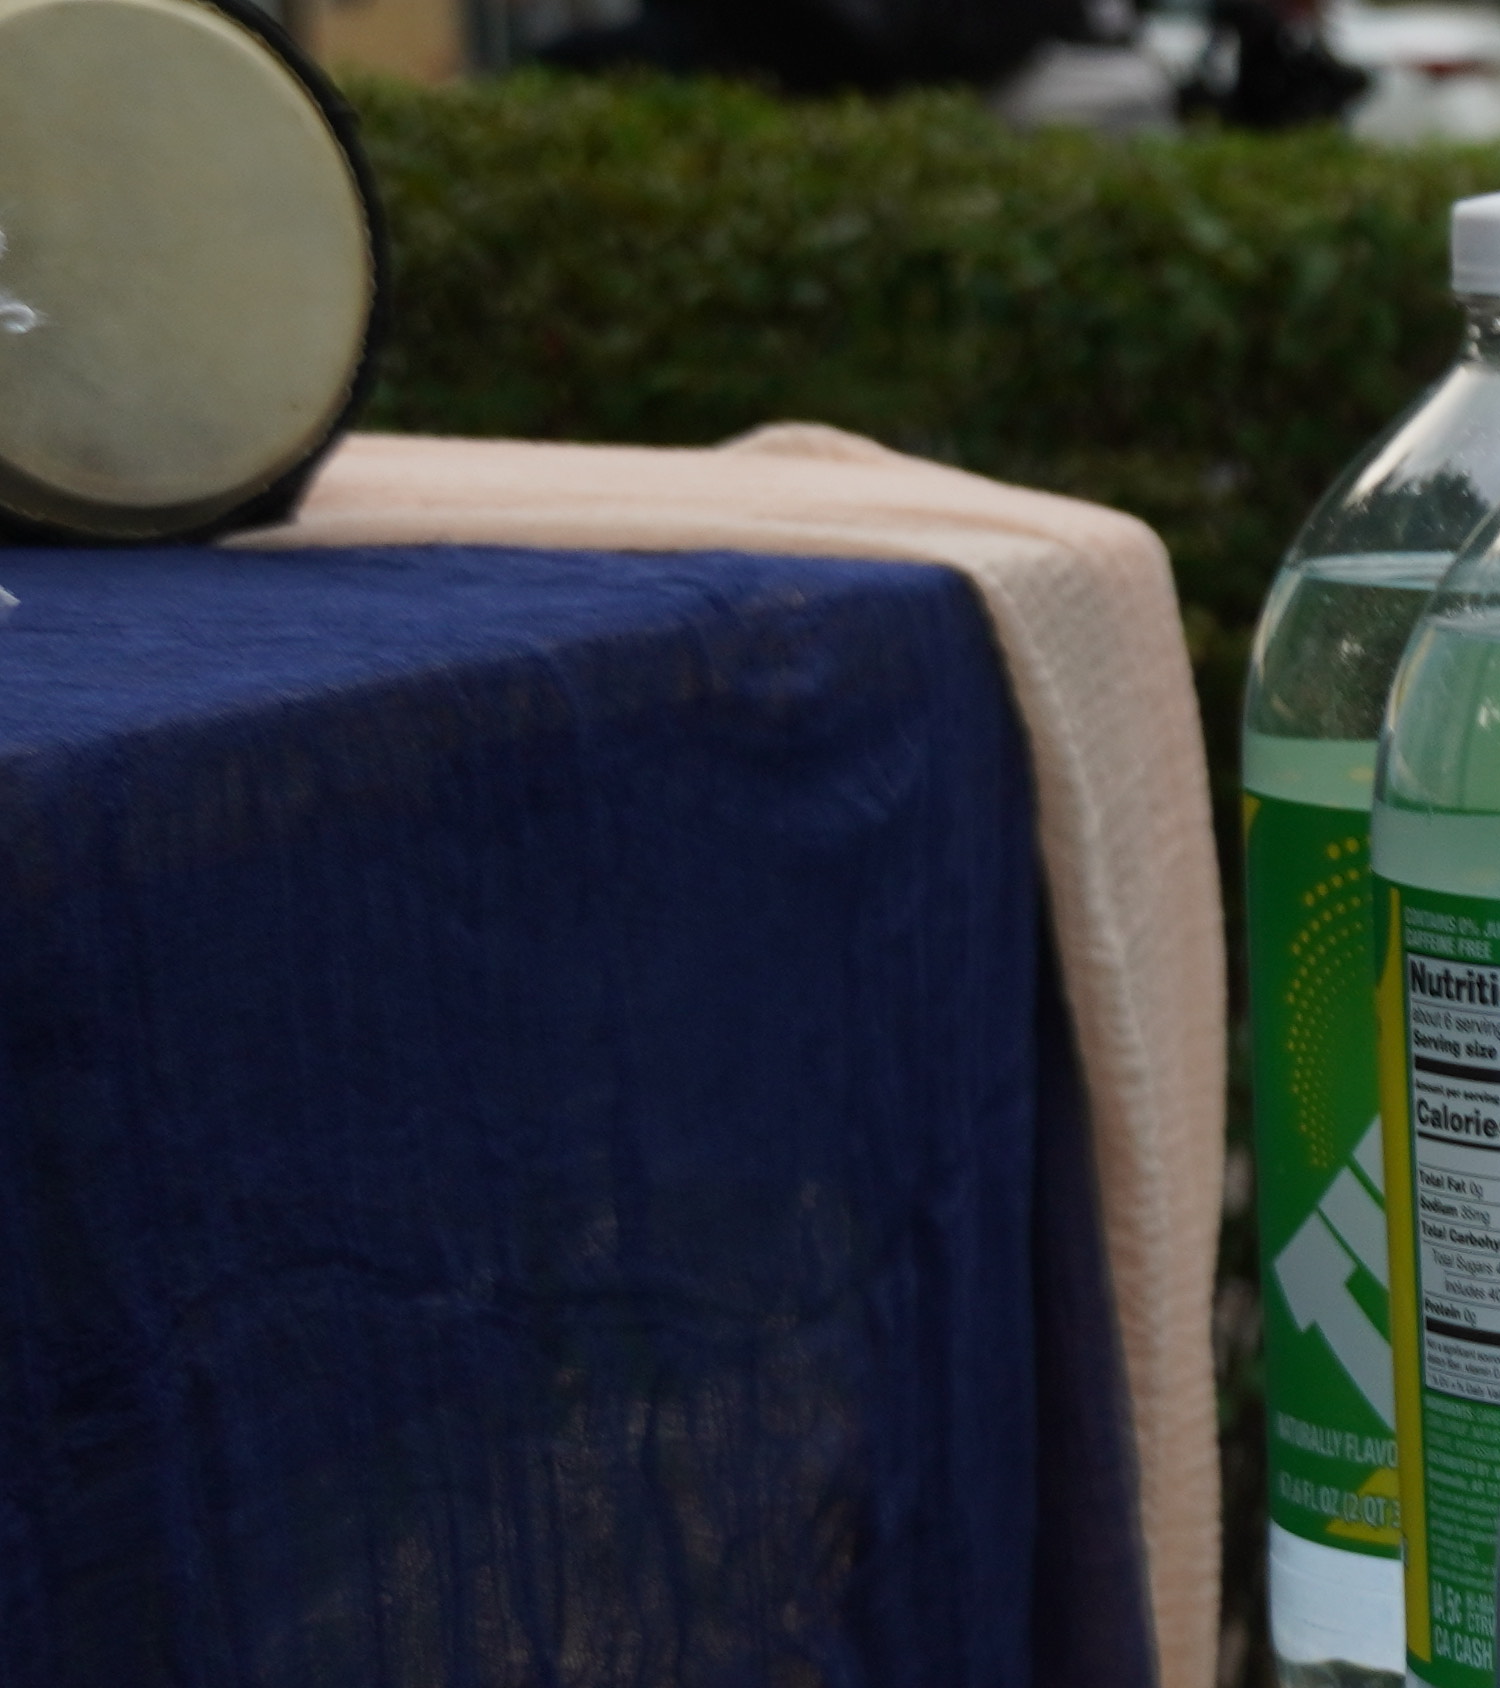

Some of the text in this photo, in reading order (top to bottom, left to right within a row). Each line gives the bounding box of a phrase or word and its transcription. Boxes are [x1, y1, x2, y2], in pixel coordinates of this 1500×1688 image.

[1412, 1011, 1442, 1029] about
[1413, 1029, 1462, 1058] Serving
[1464, 1040, 1498, 1060] size
[1419, 1169, 1445, 1188] Total
[1447, 1175, 1467, 1194] Fat
[1420, 1194, 1458, 1217] Sodium
[1421, 1220, 1446, 1240] Total
[1425, 1296, 1462, 1319] Protein
[1362, 1494, 1385, 1528] QT
[1434, 1623, 1494, 1672] CA CASH
